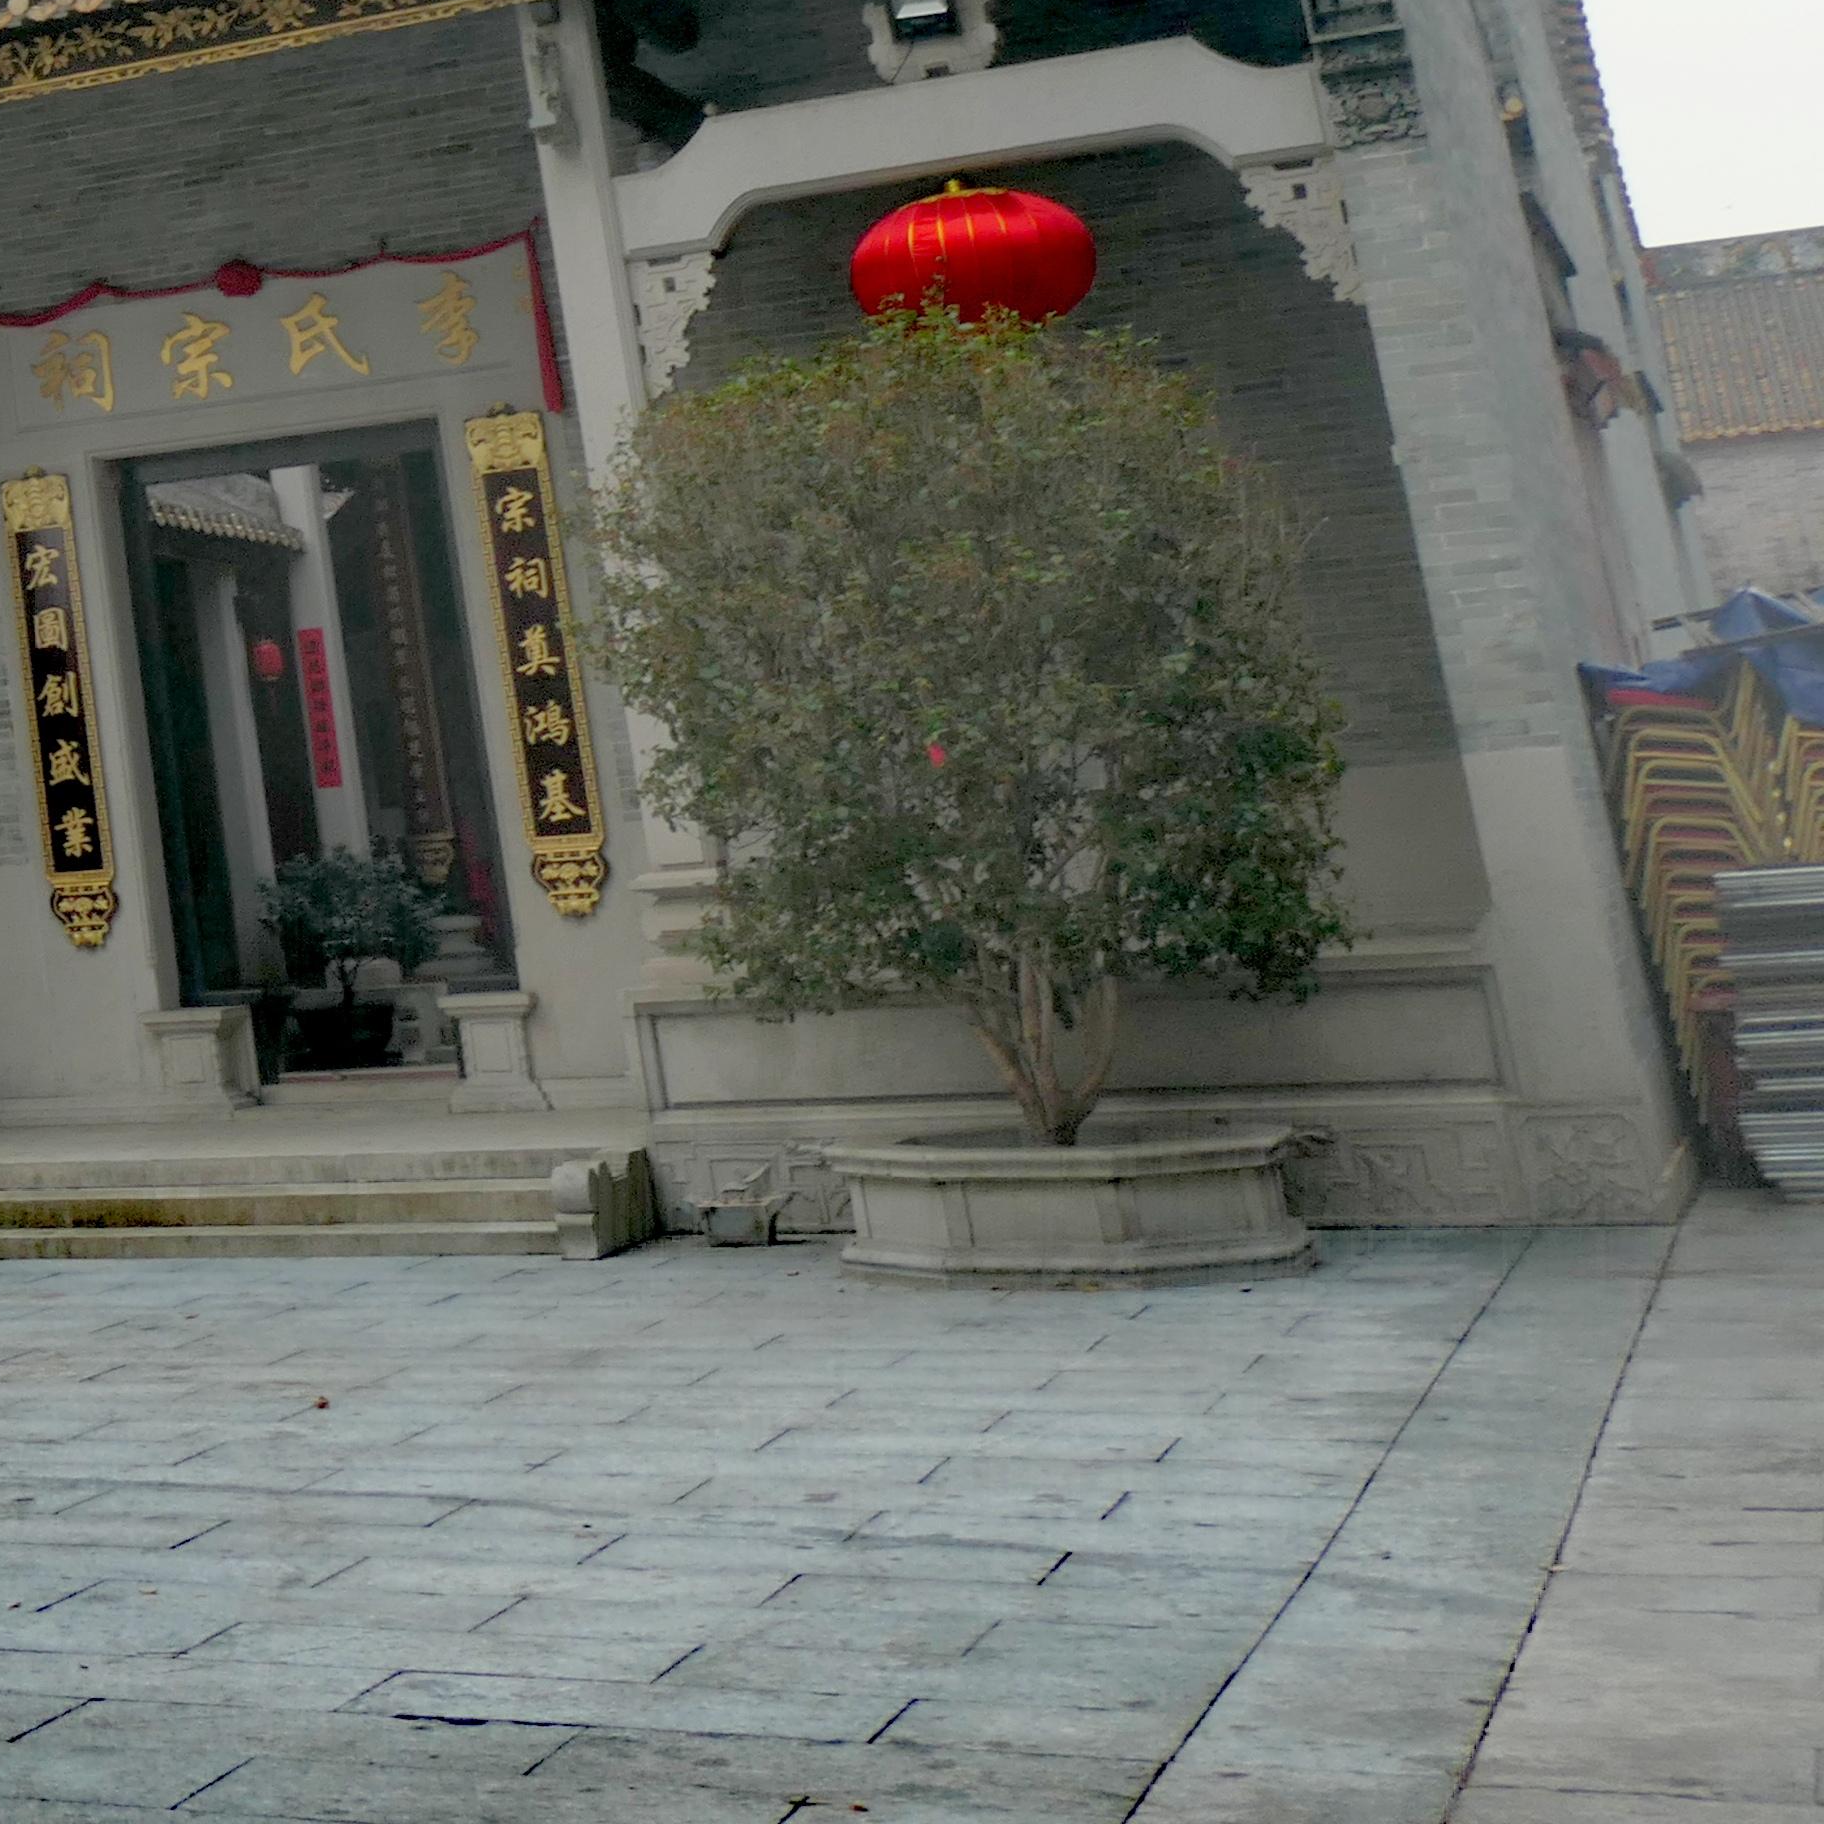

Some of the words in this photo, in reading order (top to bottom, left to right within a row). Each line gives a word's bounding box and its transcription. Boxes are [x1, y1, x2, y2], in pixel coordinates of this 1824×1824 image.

[24, 544, 95, 859] 宏圖創盛業
